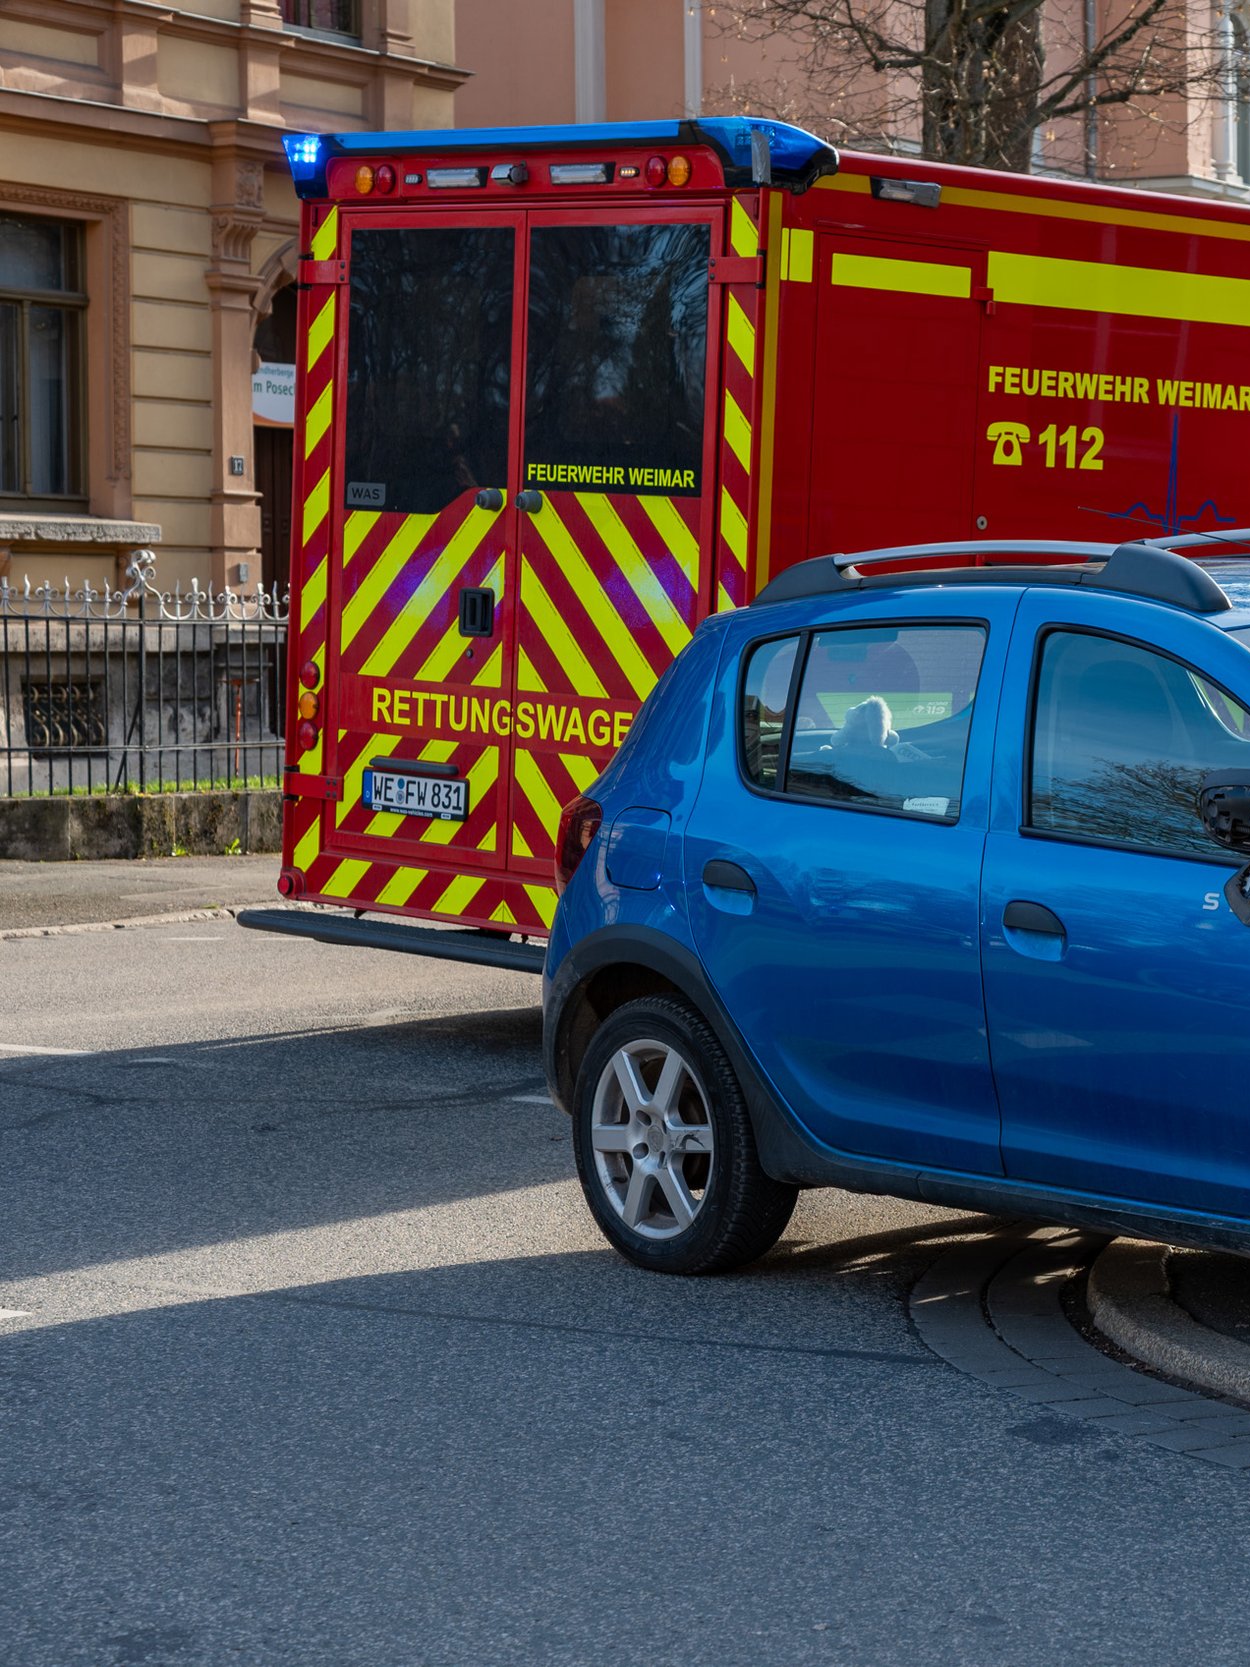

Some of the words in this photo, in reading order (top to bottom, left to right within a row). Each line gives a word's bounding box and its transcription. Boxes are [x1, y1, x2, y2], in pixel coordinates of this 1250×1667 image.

[253, 382, 263, 393] m
[266, 380, 295, 396] Posec
[988, 365, 1150, 404] FEUERWEHR
[1038, 423, 1105, 471] 112
[233, 459, 243, 472] 17
[527, 463, 625, 485] FEUERWEHR
[628, 467, 696, 489] WEIMAR
[351, 487, 381, 500] WAS
[372, 687, 634, 748] RETTUNGSWAGE
[374, 775, 395, 802] WE
[405, 780, 428, 806] FW
[431, 783, 462, 811] 831
